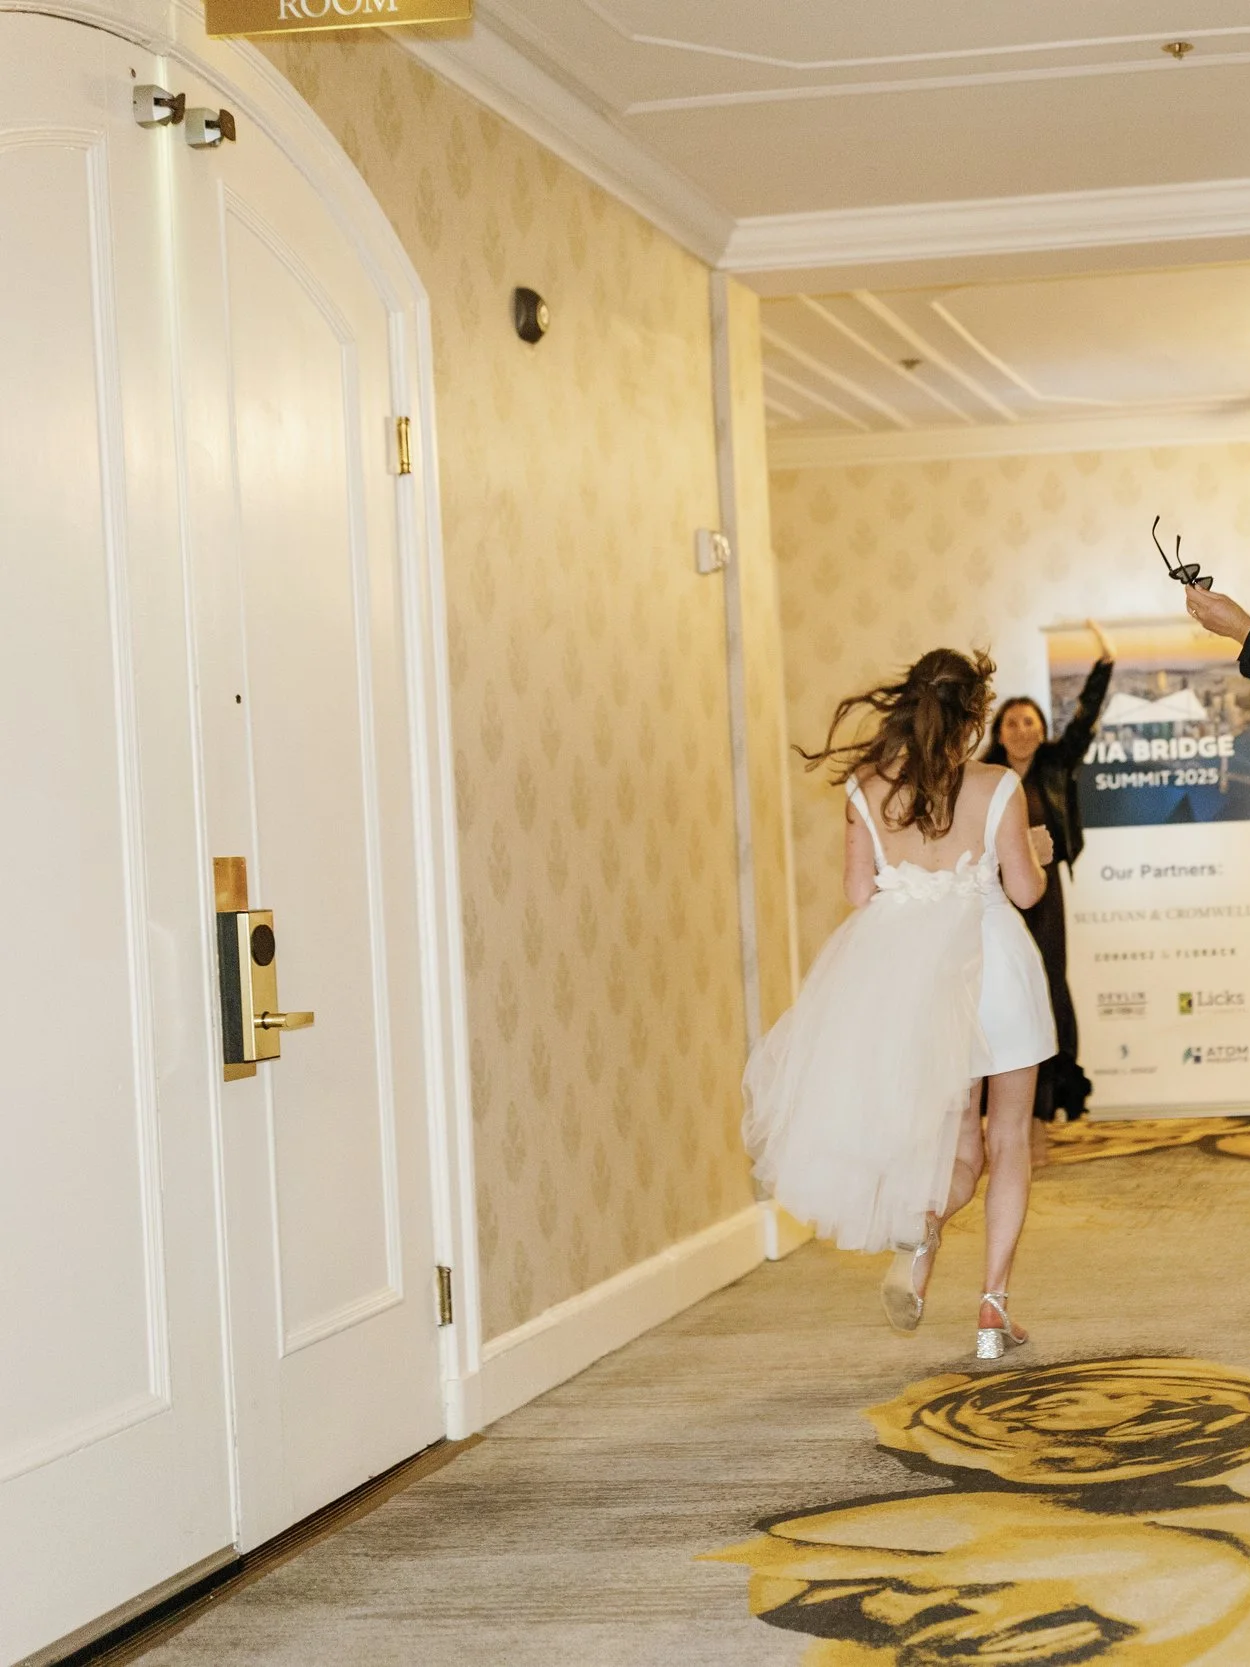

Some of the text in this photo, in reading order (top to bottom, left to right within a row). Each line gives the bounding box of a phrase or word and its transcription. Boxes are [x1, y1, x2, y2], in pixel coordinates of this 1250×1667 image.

[1133, 735, 1235, 762] BRIDGE
[1095, 767, 1219, 790] SUMMIT 2025
[1101, 863, 1223, 881] Our Partners:
[1073, 909, 1146, 925] SULLIVAN
[1196, 989, 1246, 1008] Licks
[1206, 1045, 1249, 1058] ATOM
